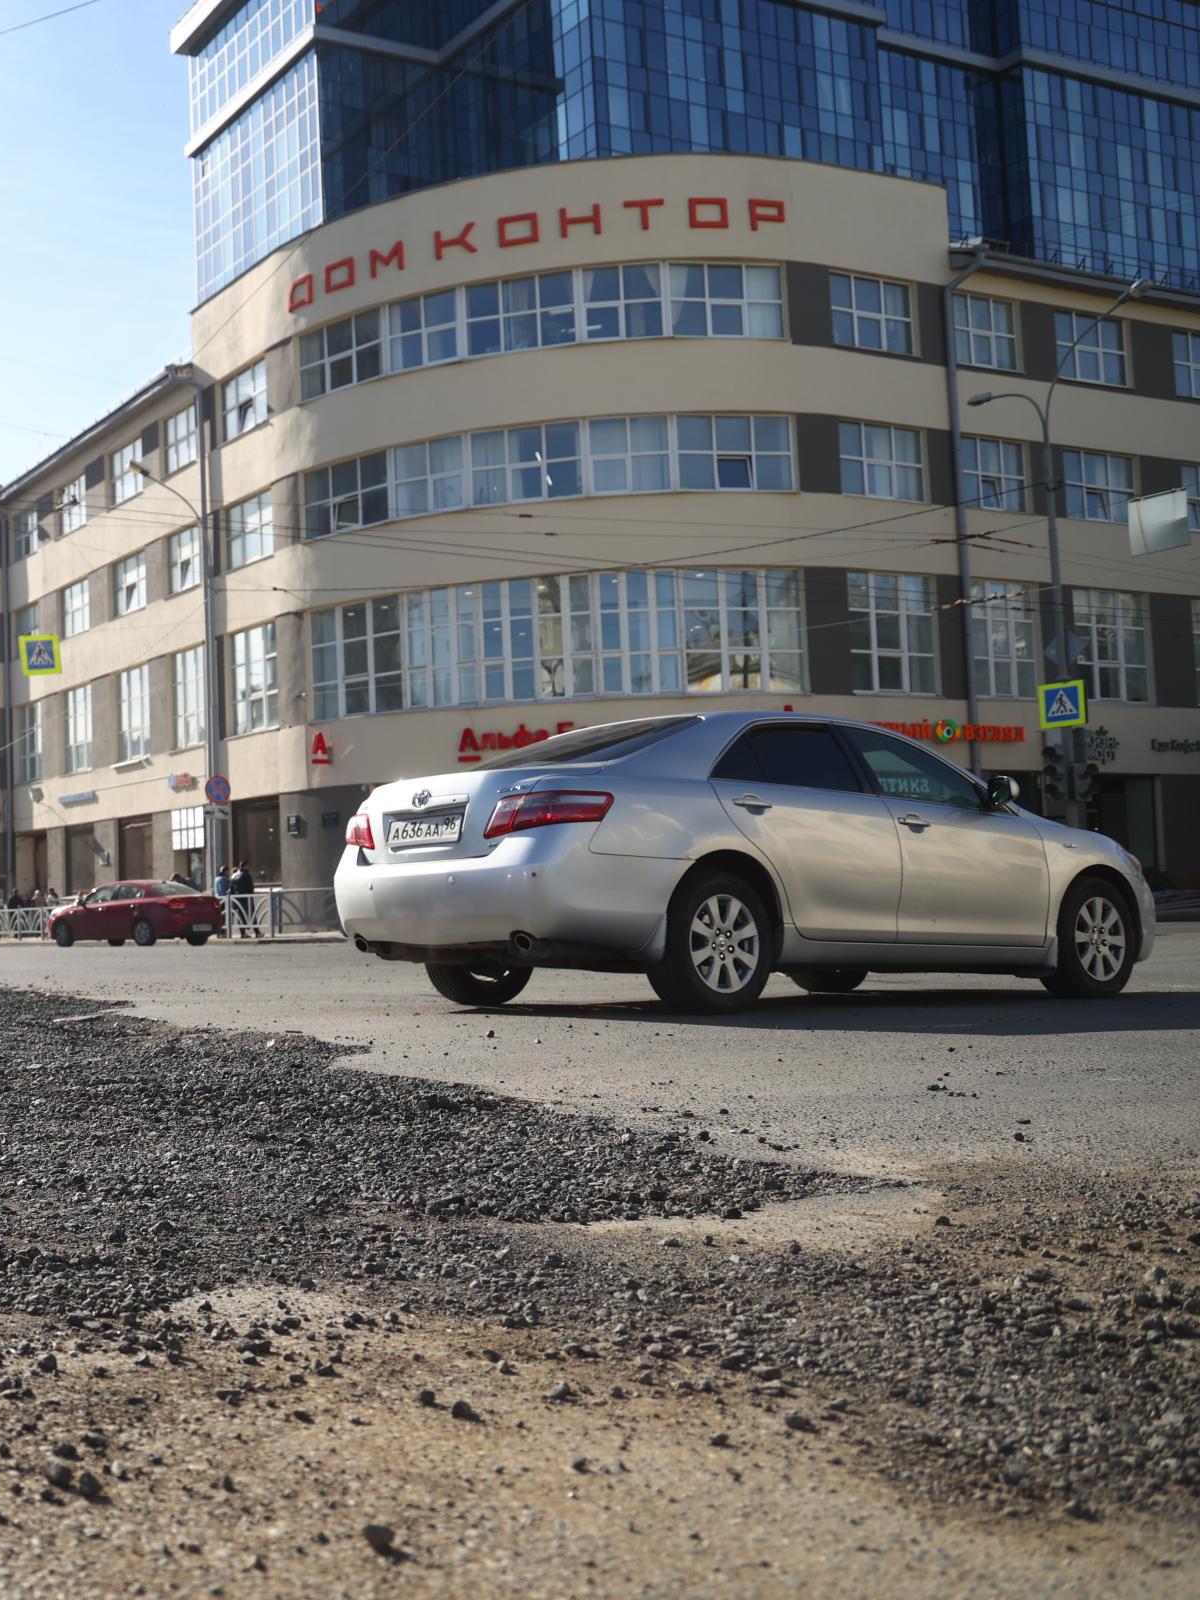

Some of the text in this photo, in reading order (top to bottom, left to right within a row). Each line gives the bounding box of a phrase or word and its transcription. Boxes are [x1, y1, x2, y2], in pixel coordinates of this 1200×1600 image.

[288, 197, 786, 314] ДОМ КОНТОР
[444, 816, 456, 831] 96
